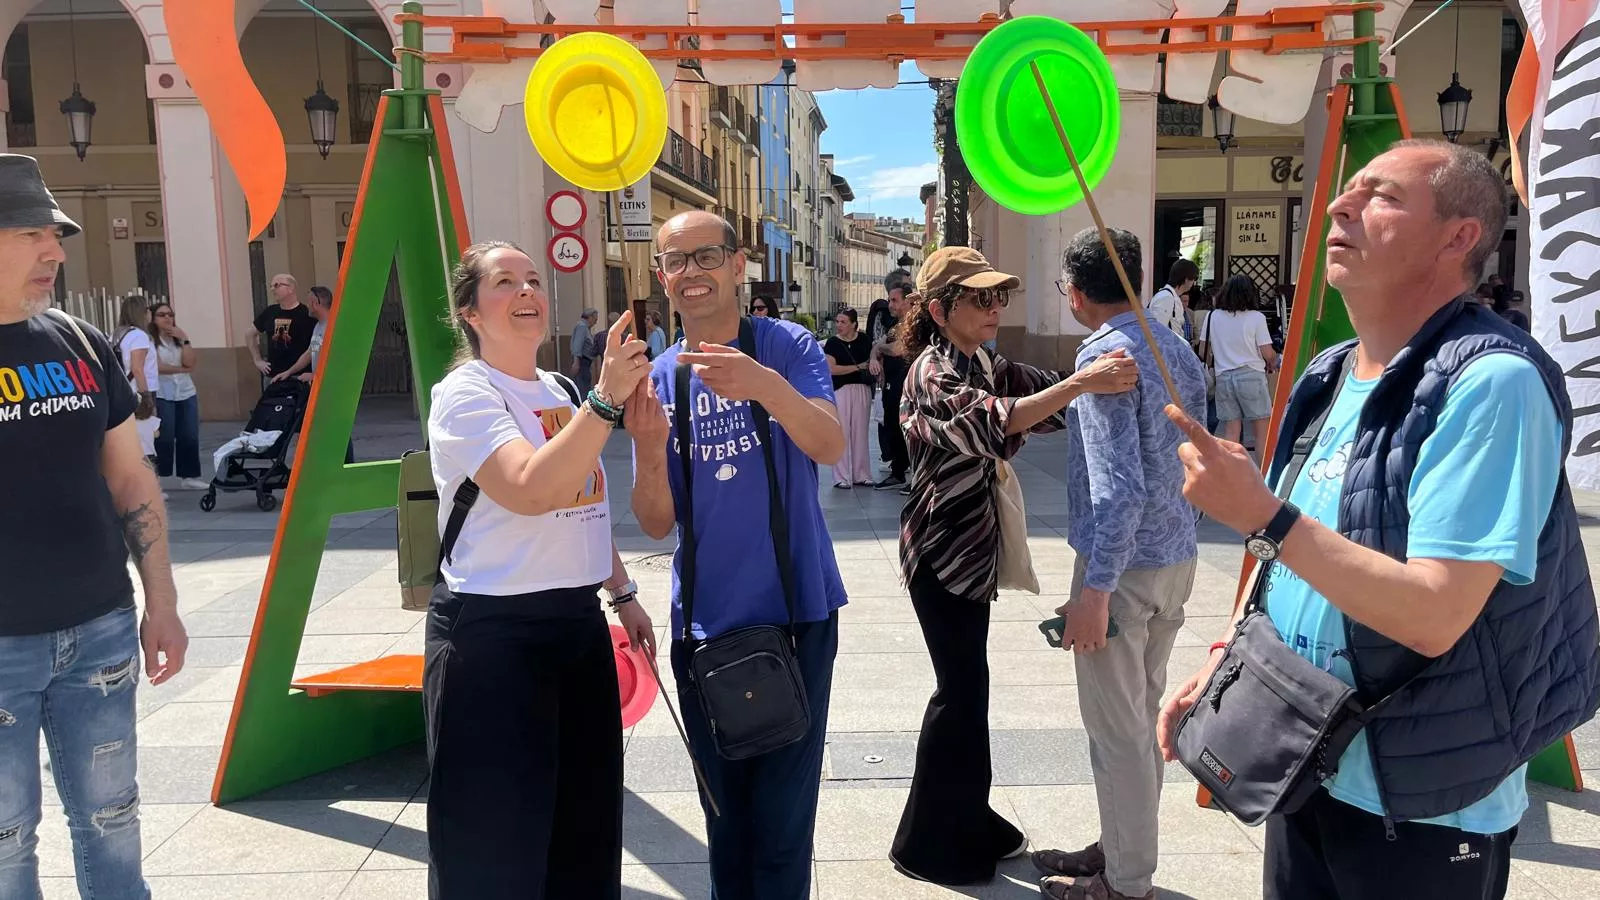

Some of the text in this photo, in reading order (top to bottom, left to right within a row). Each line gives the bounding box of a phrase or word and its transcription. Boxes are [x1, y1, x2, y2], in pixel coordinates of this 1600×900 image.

[145, 211, 163, 227] S
[1239, 223, 1261, 231] PERO
[1238, 233, 1267, 243] SIN LL
[0, 359, 100, 403] OMBIA
